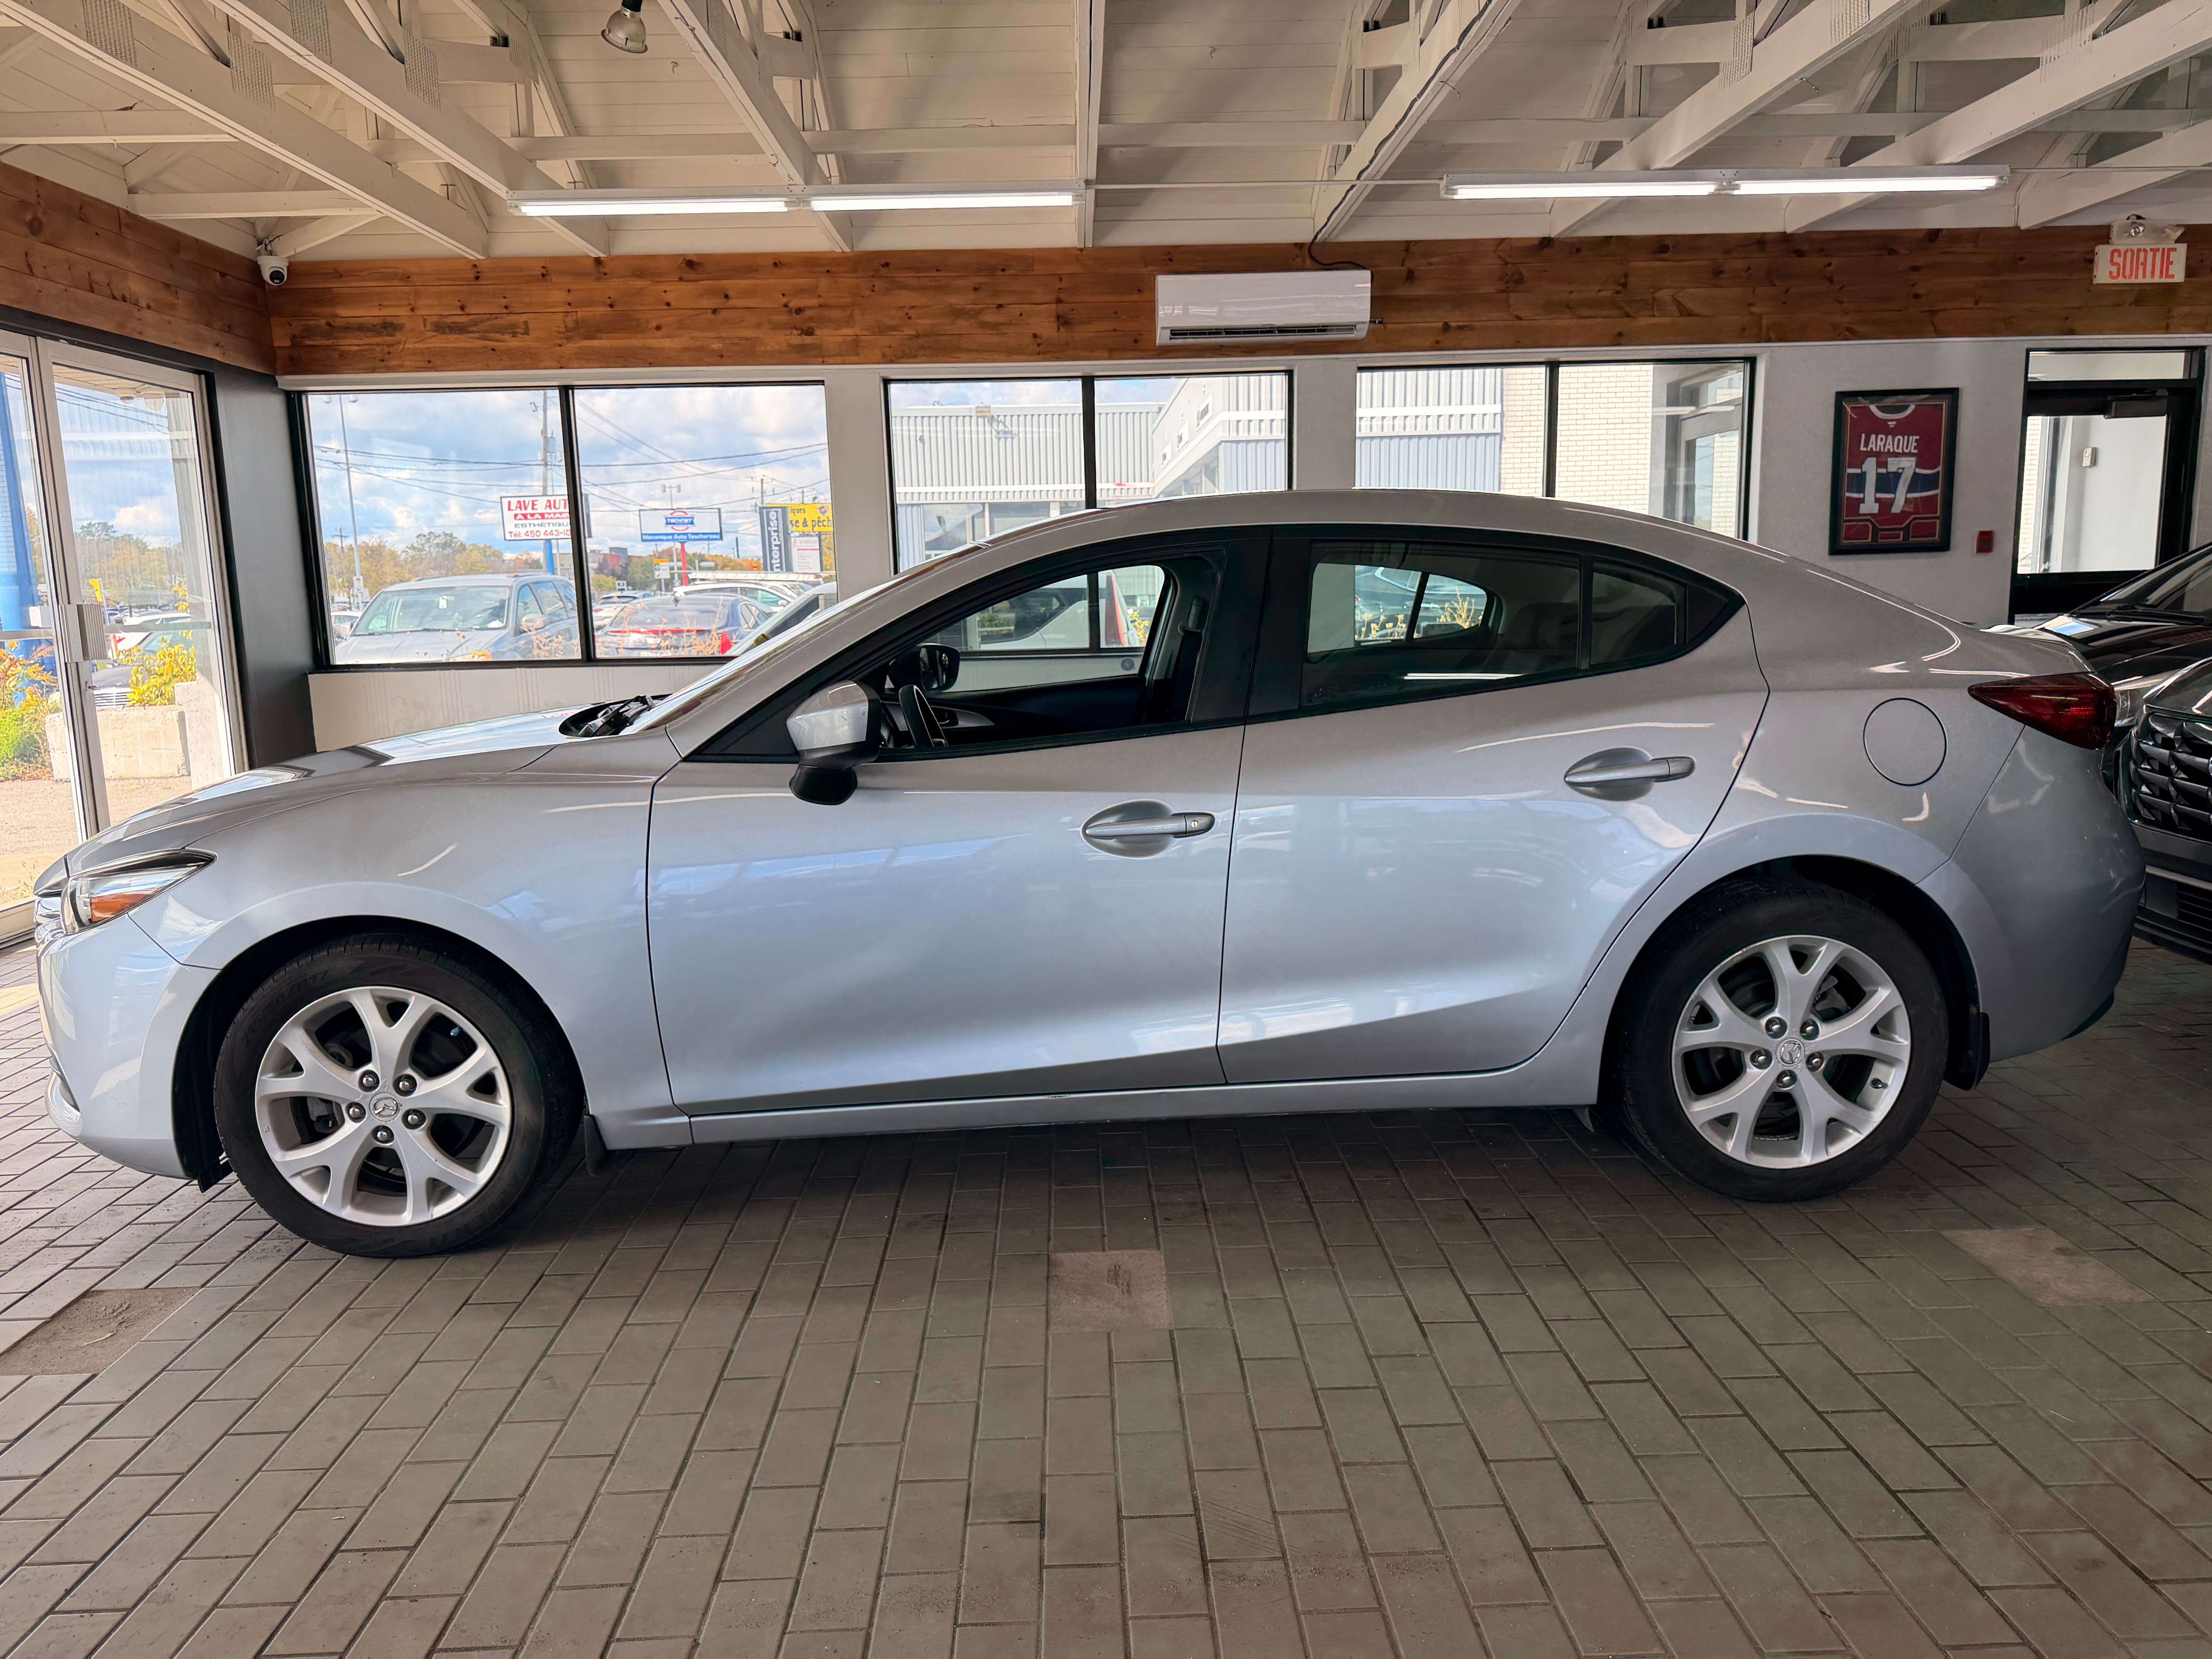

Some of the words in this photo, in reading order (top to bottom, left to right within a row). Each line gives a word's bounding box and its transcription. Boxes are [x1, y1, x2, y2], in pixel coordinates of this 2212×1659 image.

[2109, 247, 2177, 280] SORTIE
[1860, 433, 1920, 453] LARAQUE
[1859, 457, 1916, 514] 17
[508, 500, 538, 511] LAVE
[544, 499, 569, 510] AUT
[790, 506, 806, 516] iques
[802, 518, 809, 527] &
[811, 516, 832, 531] pêch
[768, 511, 781, 572] nterprise
